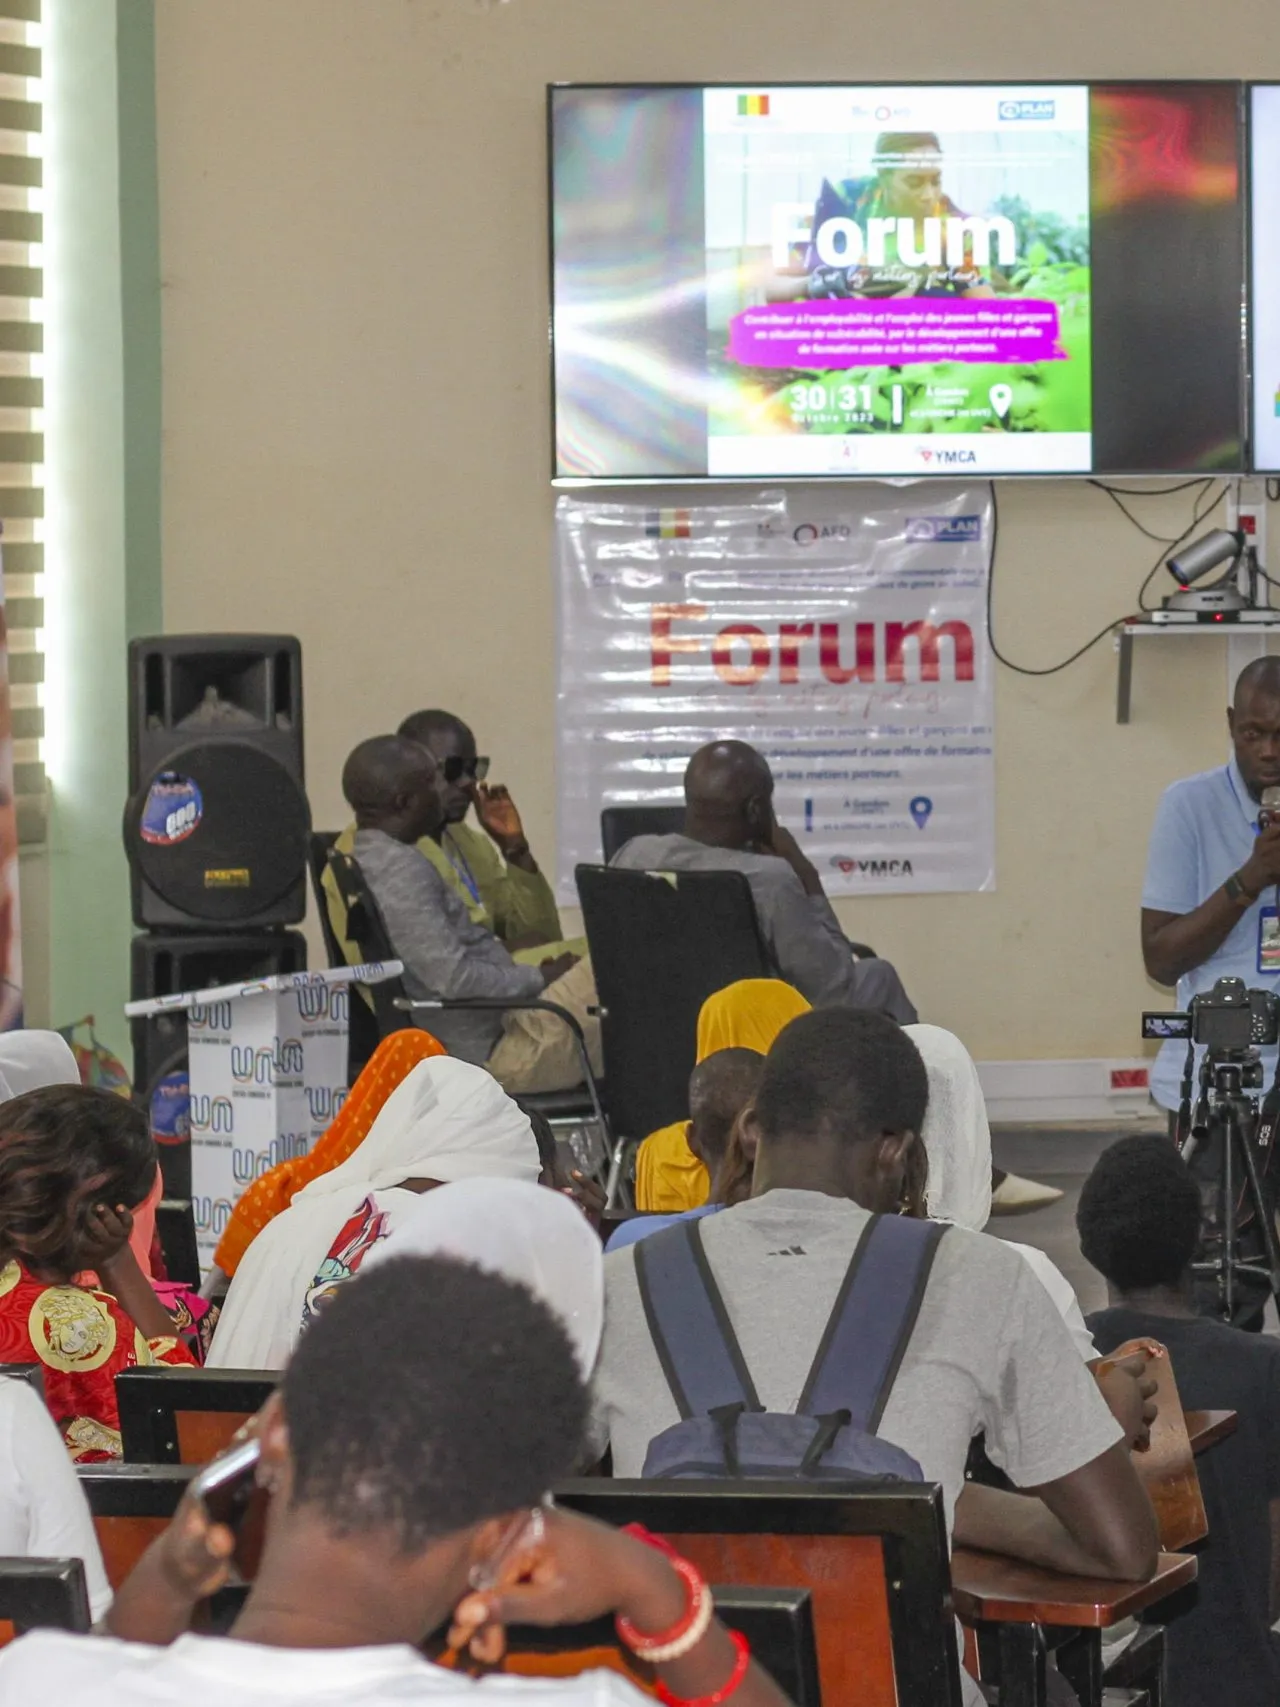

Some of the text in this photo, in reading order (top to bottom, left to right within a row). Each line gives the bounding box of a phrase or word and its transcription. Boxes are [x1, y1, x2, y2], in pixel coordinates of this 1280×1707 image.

[772, 202, 1016, 268] Forum
[790, 385, 873, 411] 30 31
[935, 450, 977, 464] YMCA
[821, 525, 850, 538] AFD
[937, 519, 979, 533] PLAN
[650, 603, 975, 687] Forum
[166, 801, 196, 836] 600
[858, 860, 914, 877] YMCA
[1258, 1124, 1272, 1147] EOS
